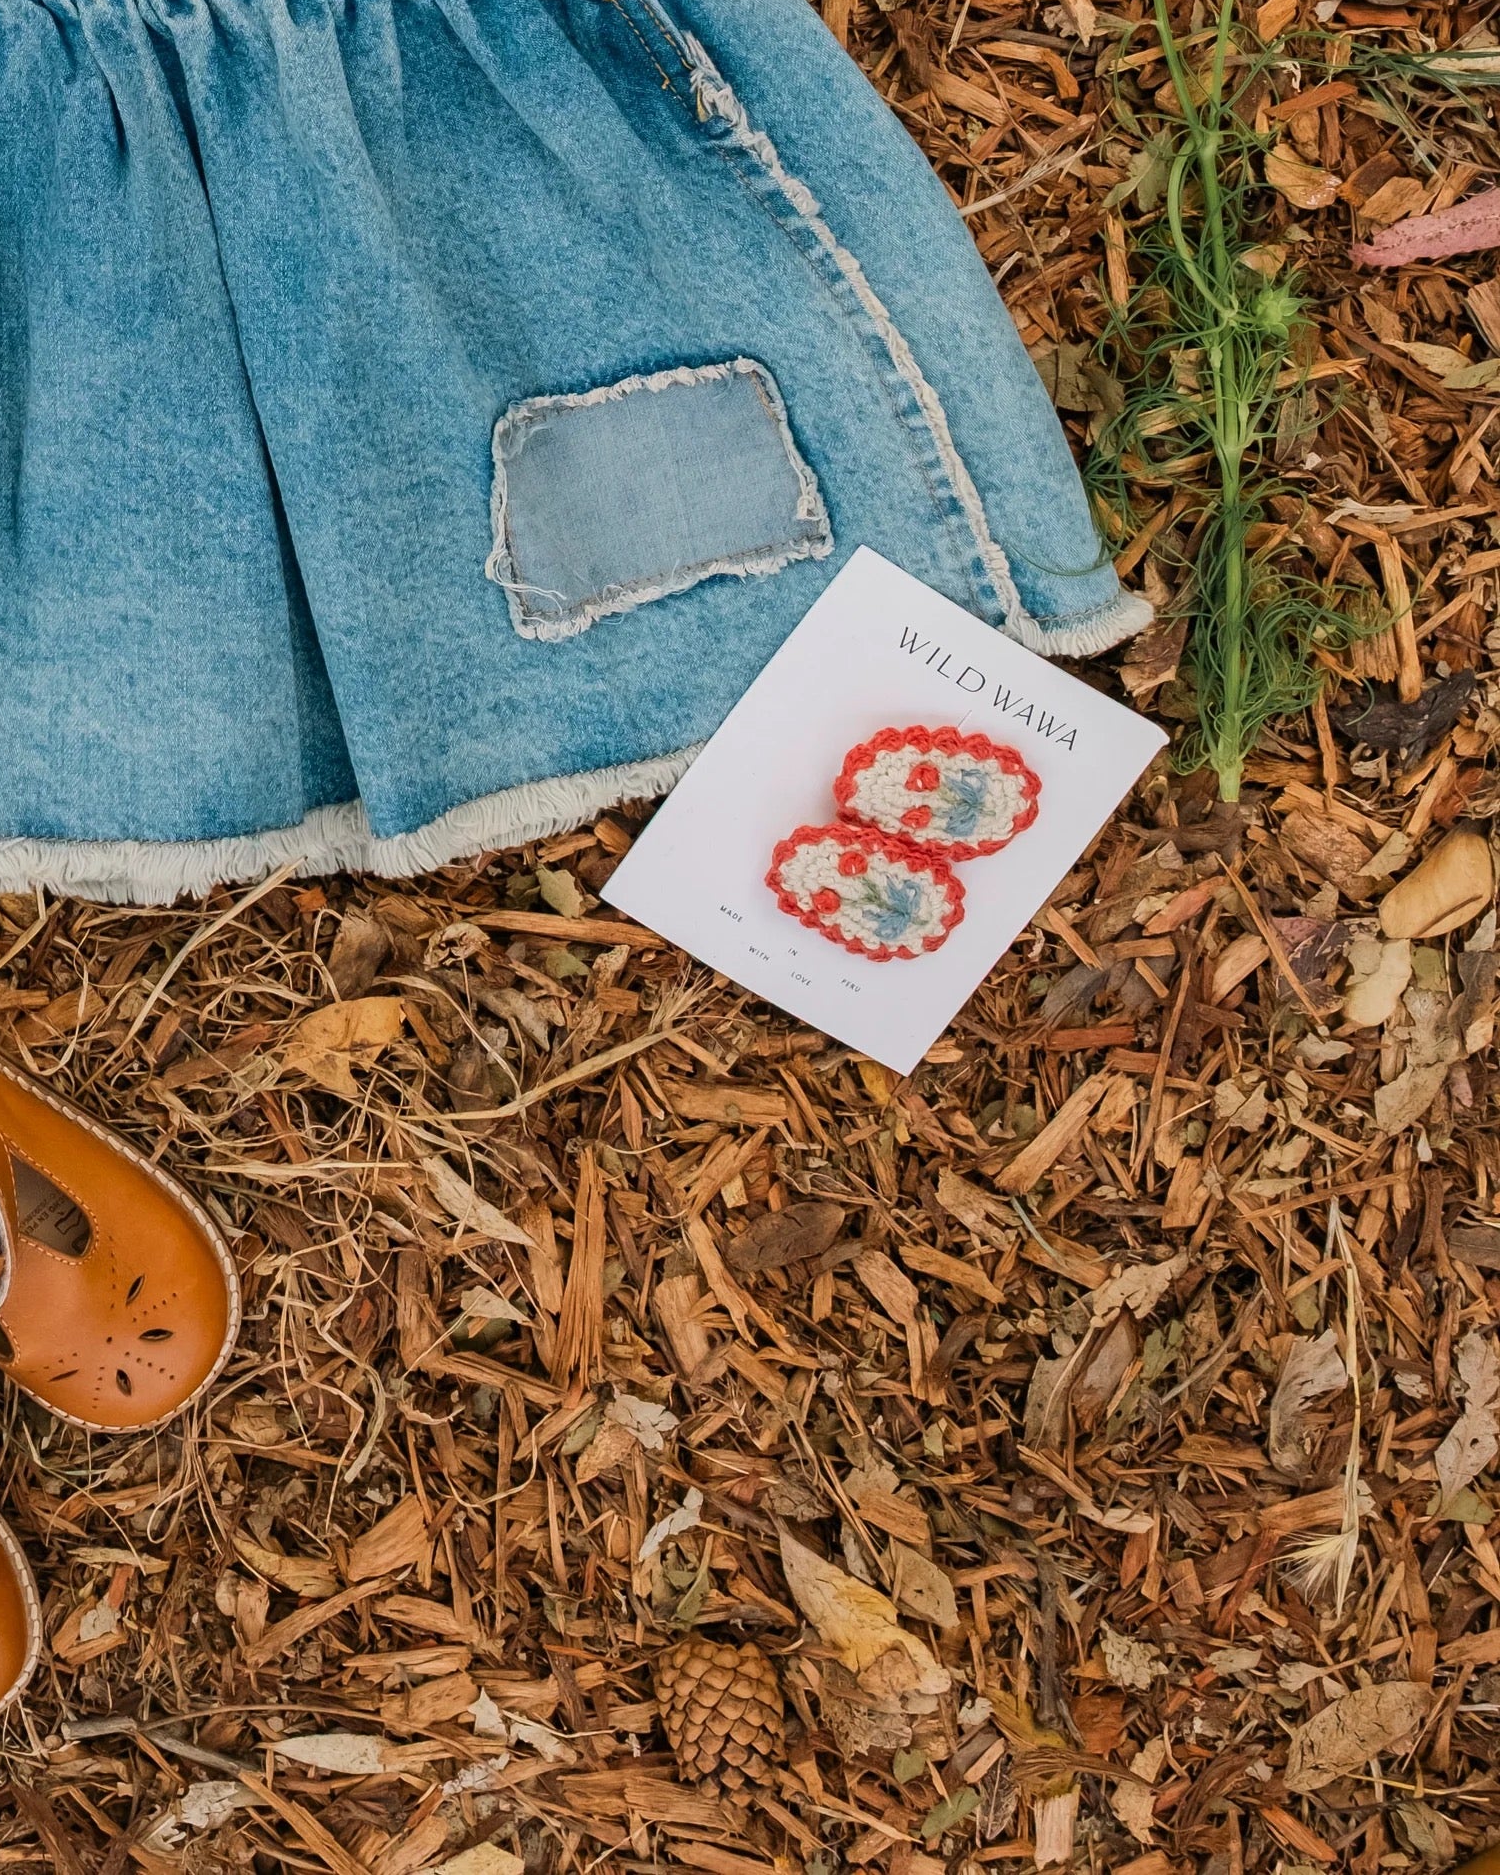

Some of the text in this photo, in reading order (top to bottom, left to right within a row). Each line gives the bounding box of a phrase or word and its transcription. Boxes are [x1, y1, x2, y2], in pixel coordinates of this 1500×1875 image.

[899, 626, 1077, 751] WILD WAWA
[719, 904, 862, 993] MADE IN PERU
[748, 945, 813, 987] WITH LOVE
